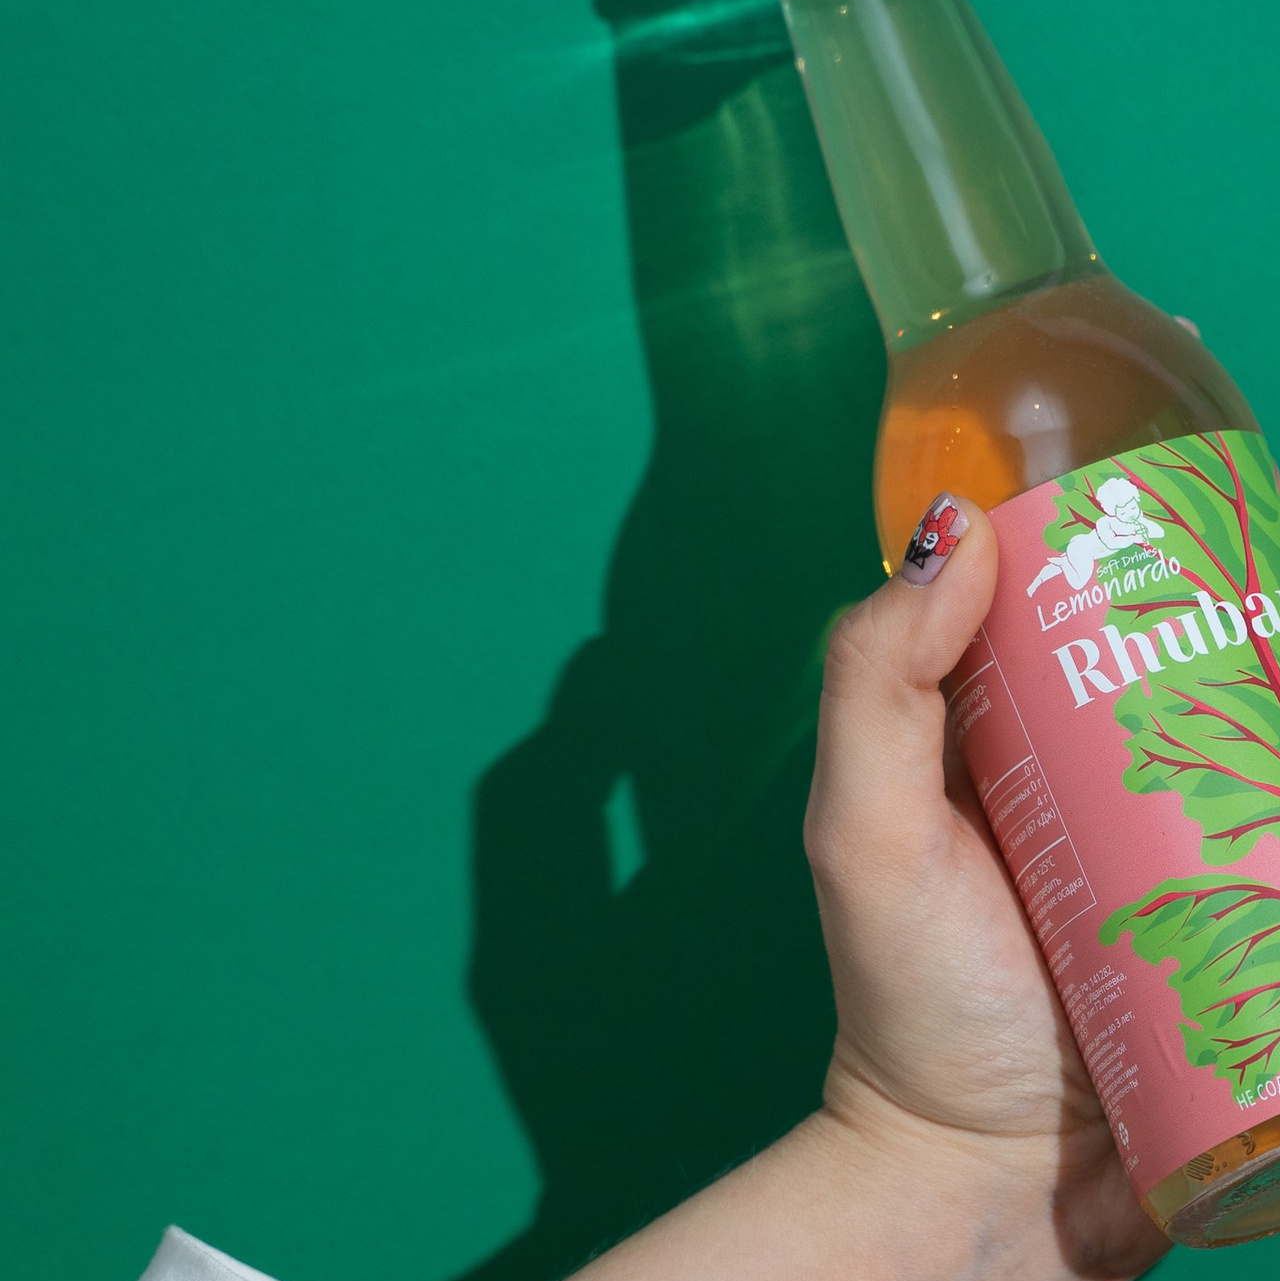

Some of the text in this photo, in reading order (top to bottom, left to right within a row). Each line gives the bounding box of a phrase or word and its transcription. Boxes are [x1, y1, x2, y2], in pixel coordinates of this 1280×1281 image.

[1096, 547, 1158, 578] Soft Drinks
[1037, 549, 1181, 632] Lemonardo
[1030, 780, 1037, 792] 0
[1026, 820, 1036, 837] (67
[1037, 807, 1056, 827] кДж)
[1057, 877, 1084, 902] осадка
[1090, 965, 1114, 986] 141282,
[1107, 1025, 1116, 1035] до
[1114, 1018, 1121, 1028] 3
[1121, 1011, 1136, 1024] лет,
[1235, 1090, 1256, 1111] НЕ
